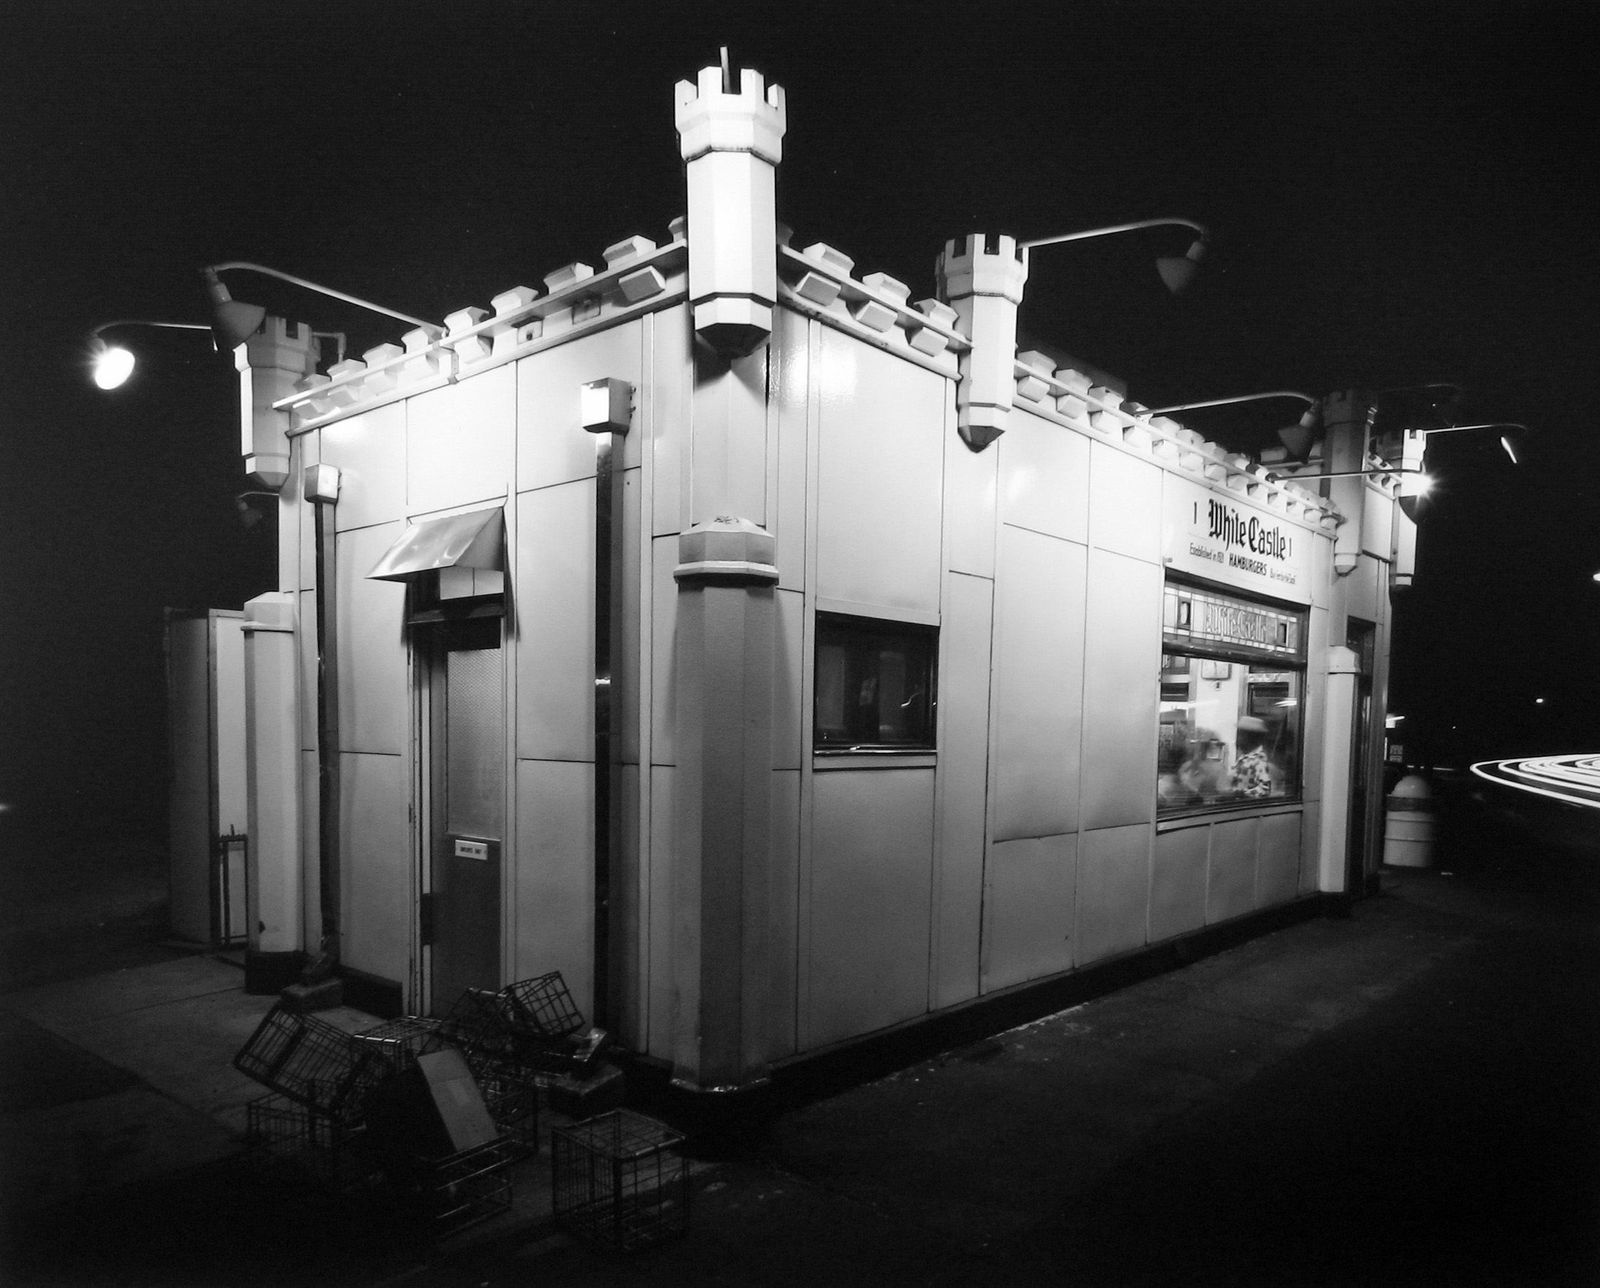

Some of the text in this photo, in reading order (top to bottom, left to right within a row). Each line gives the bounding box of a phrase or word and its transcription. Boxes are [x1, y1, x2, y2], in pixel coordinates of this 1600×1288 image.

[1208, 499, 1286, 561] White Castle
[1229, 552, 1267, 576] HAMBURGERS
